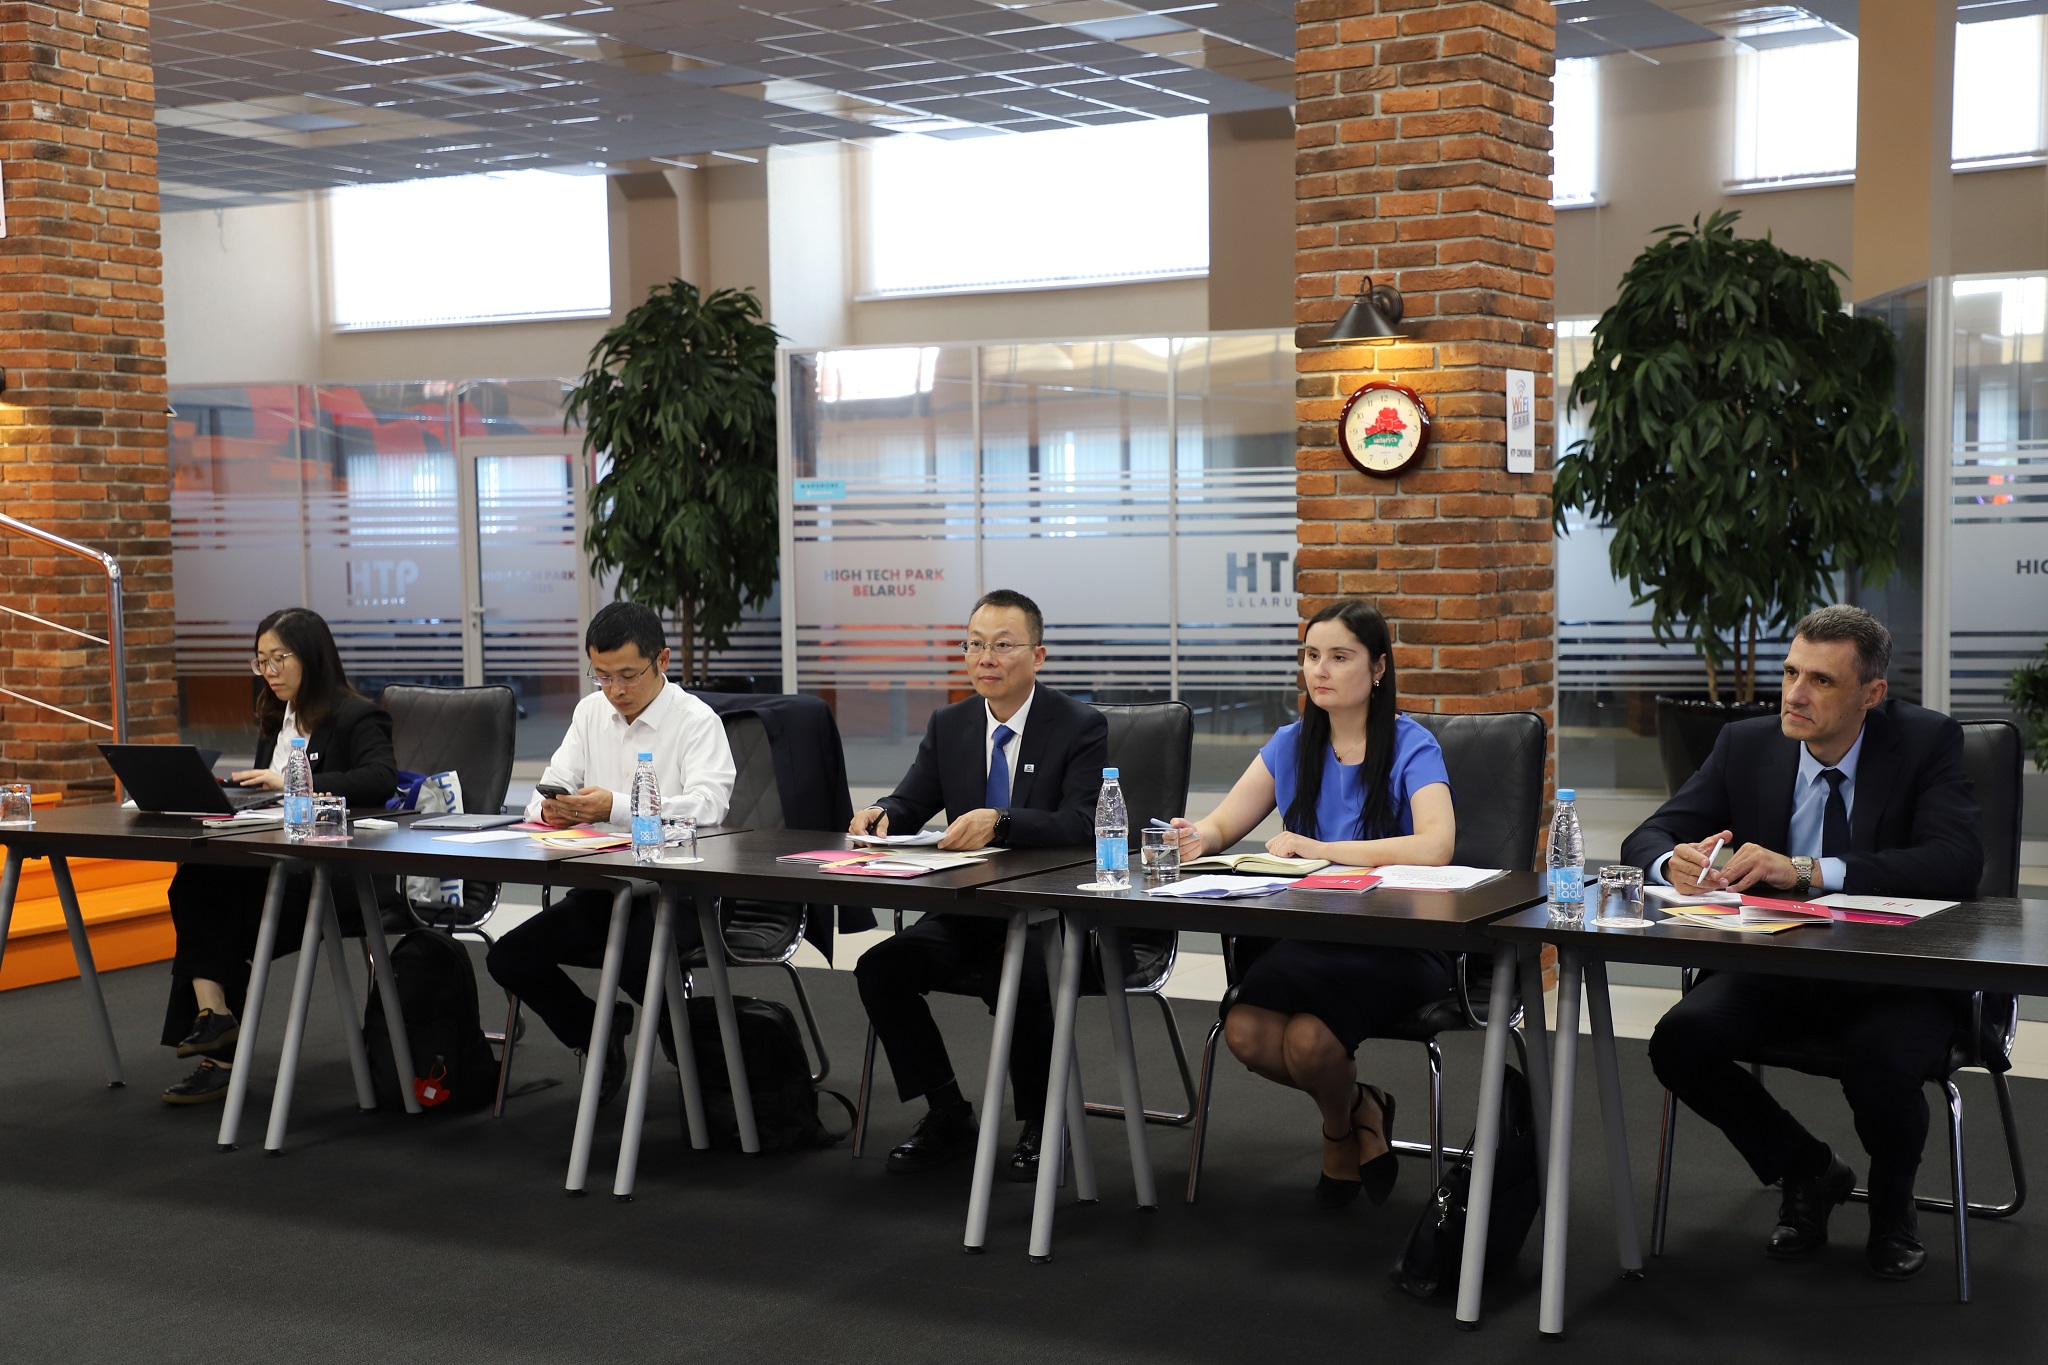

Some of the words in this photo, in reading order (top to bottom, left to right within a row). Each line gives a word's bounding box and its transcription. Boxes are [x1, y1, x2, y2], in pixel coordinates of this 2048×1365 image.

[1512, 394, 1529, 414] WiFi
[346, 560, 419, 595] HTP
[545, 570, 576, 580] PARK
[824, 569, 862, 581] HIGH
[867, 569, 900, 581] TECH
[905, 569, 944, 581] PARK
[1227, 552, 1300, 592] HT
[853, 584, 916, 597] BELARUS
